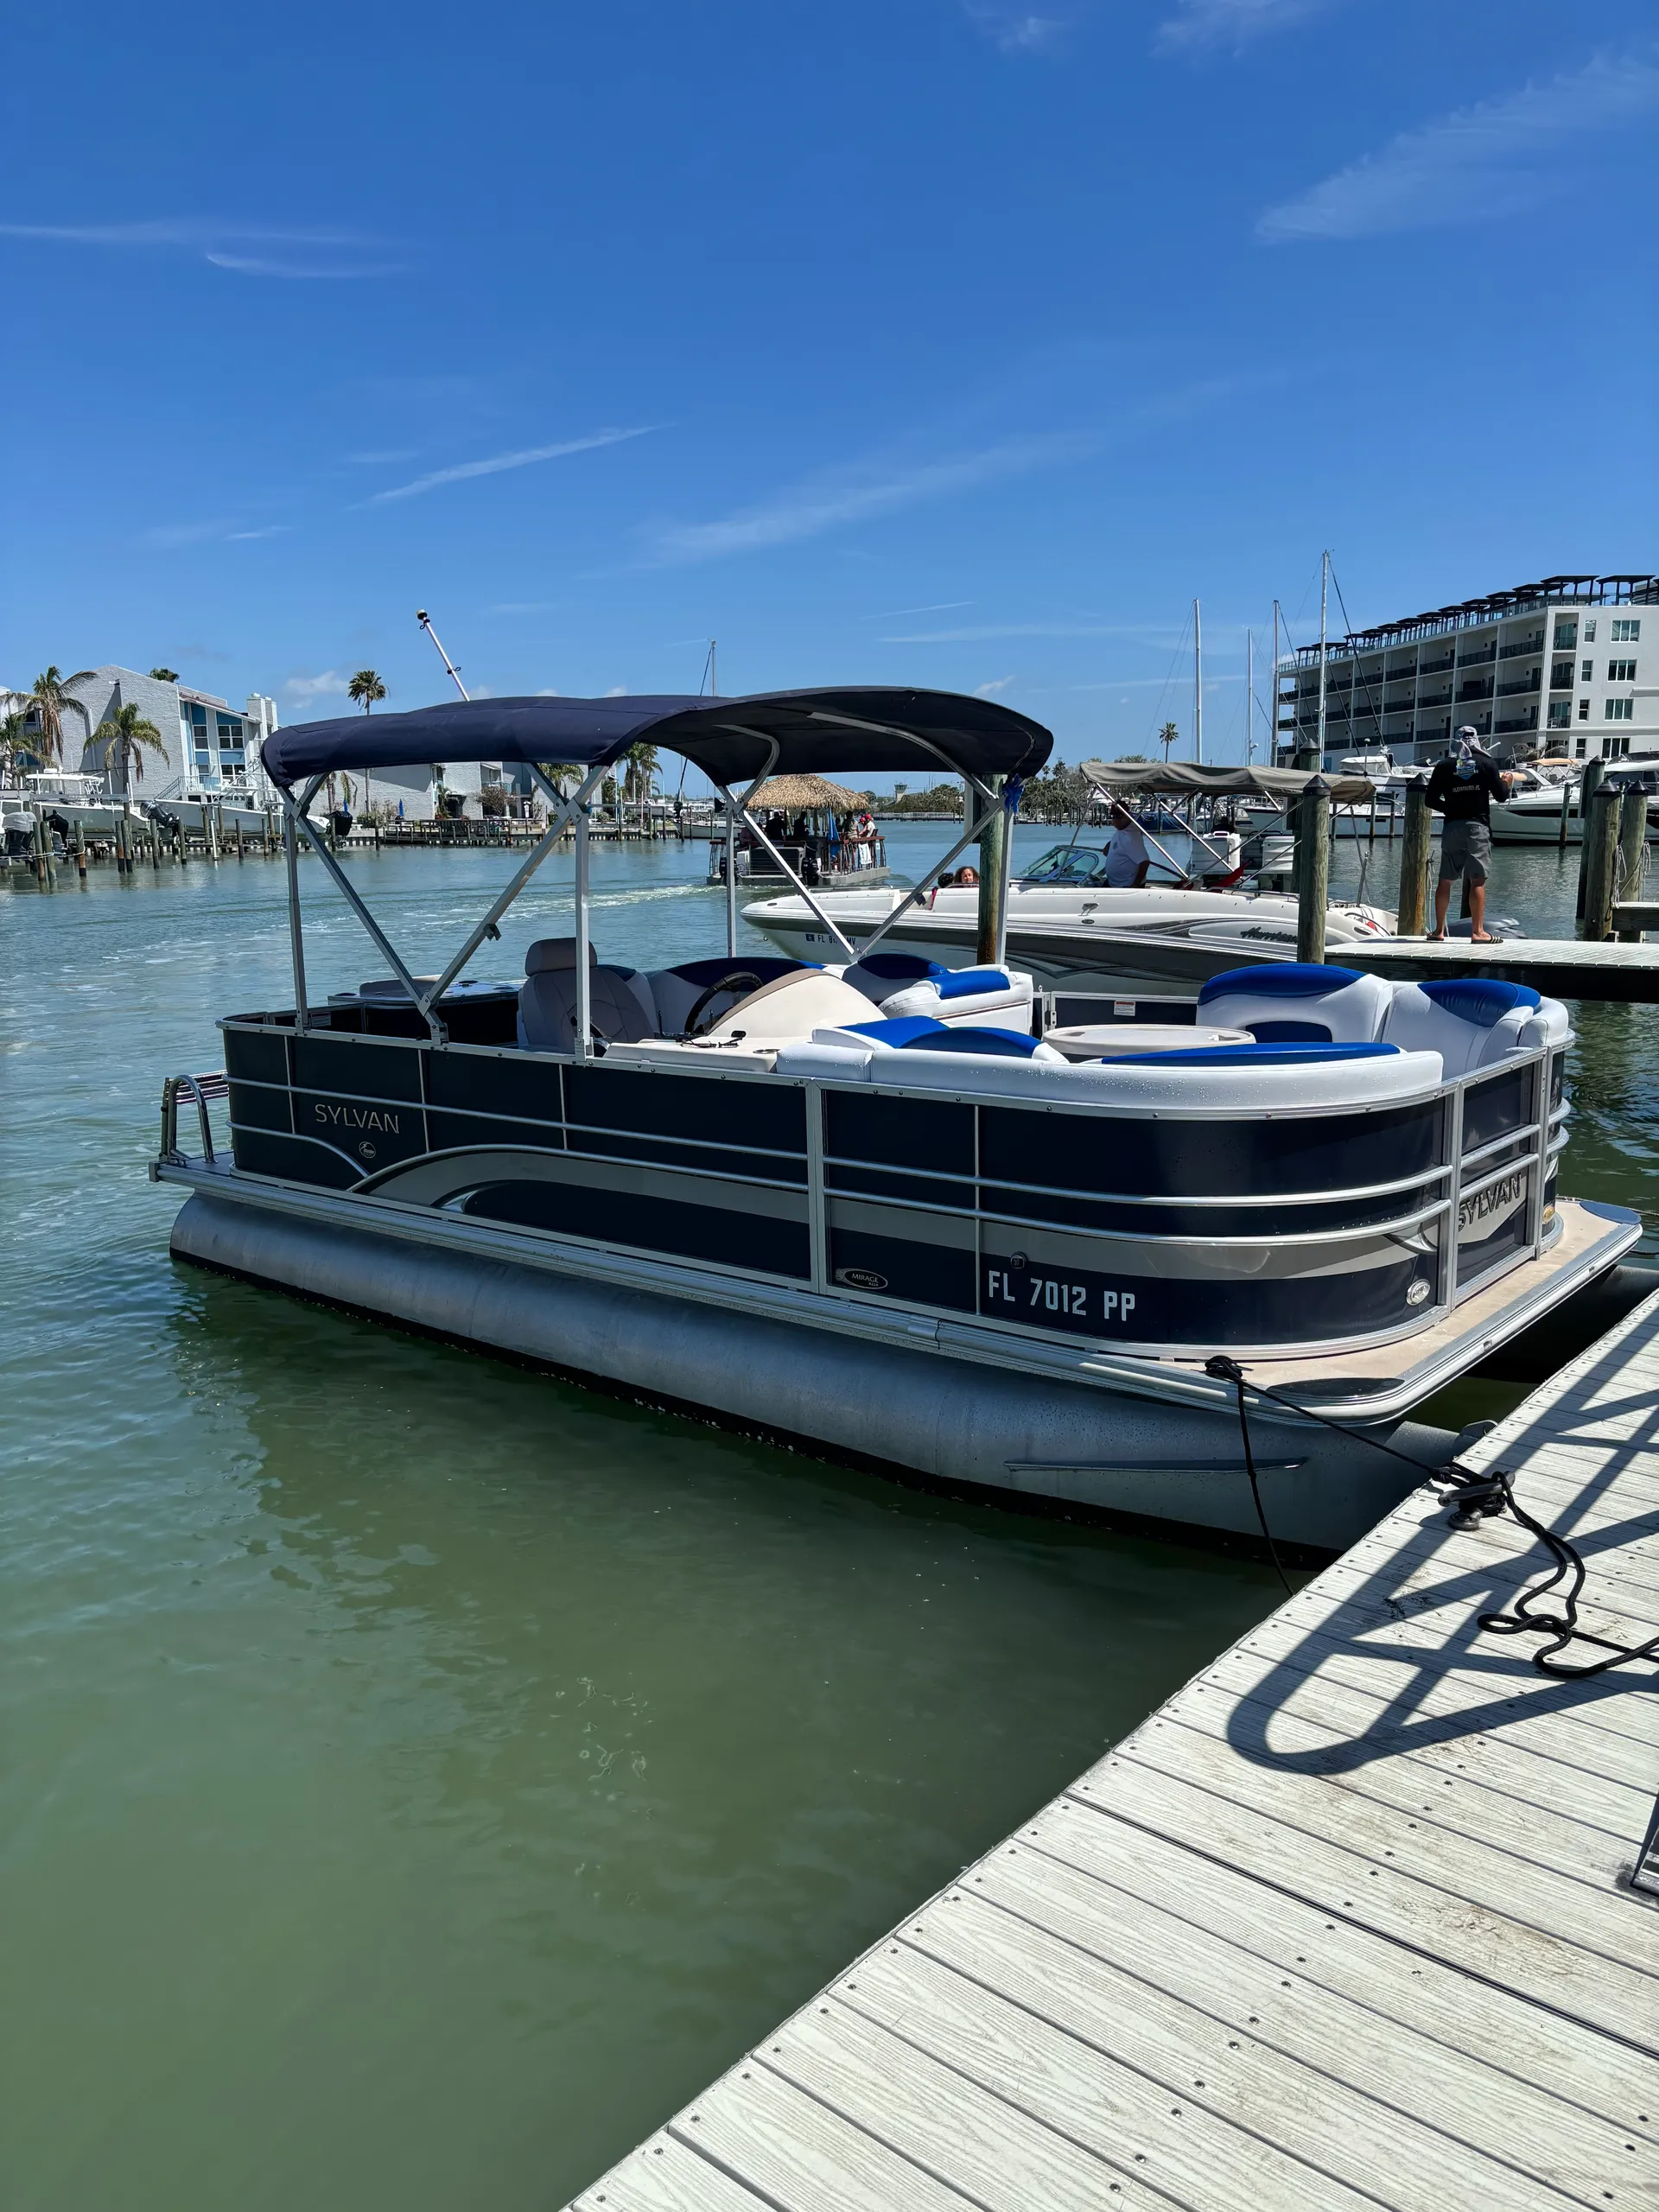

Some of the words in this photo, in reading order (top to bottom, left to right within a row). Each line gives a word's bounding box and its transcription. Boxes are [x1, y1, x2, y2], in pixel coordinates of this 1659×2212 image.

[315, 1103, 399, 1134] SYLVAN
[851, 1273, 879, 1283] MIRAGE
[988, 1270, 1015, 1302] FL
[1030, 1277, 1087, 1316] 7012
[1103, 1290, 1135, 1321] PP
